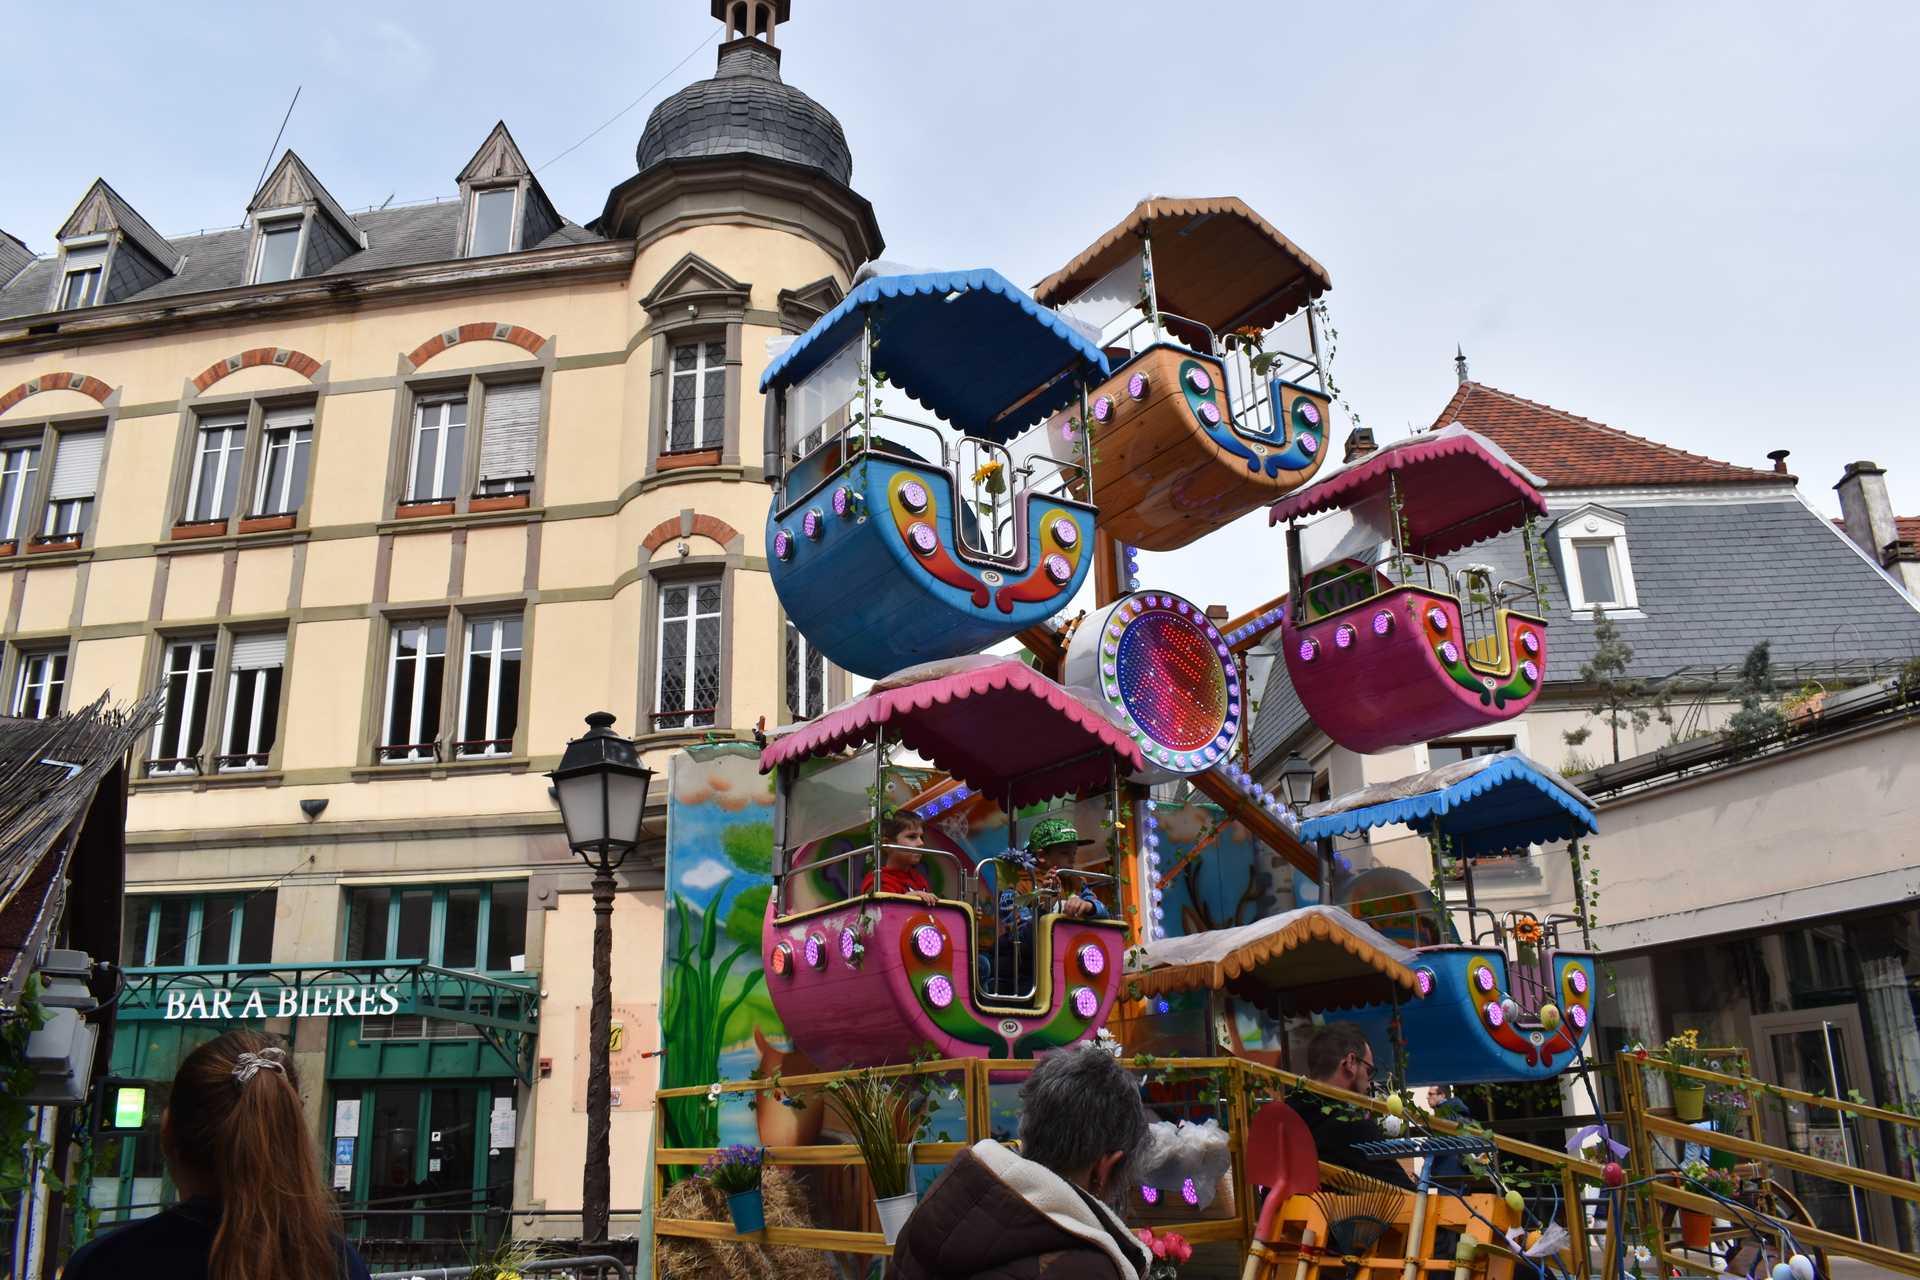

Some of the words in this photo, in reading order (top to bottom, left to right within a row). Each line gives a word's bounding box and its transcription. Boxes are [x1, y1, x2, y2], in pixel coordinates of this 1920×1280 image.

[164, 987, 233, 1019] BAR
[239, 988, 267, 1018] A
[276, 983, 399, 1017] BIERES
